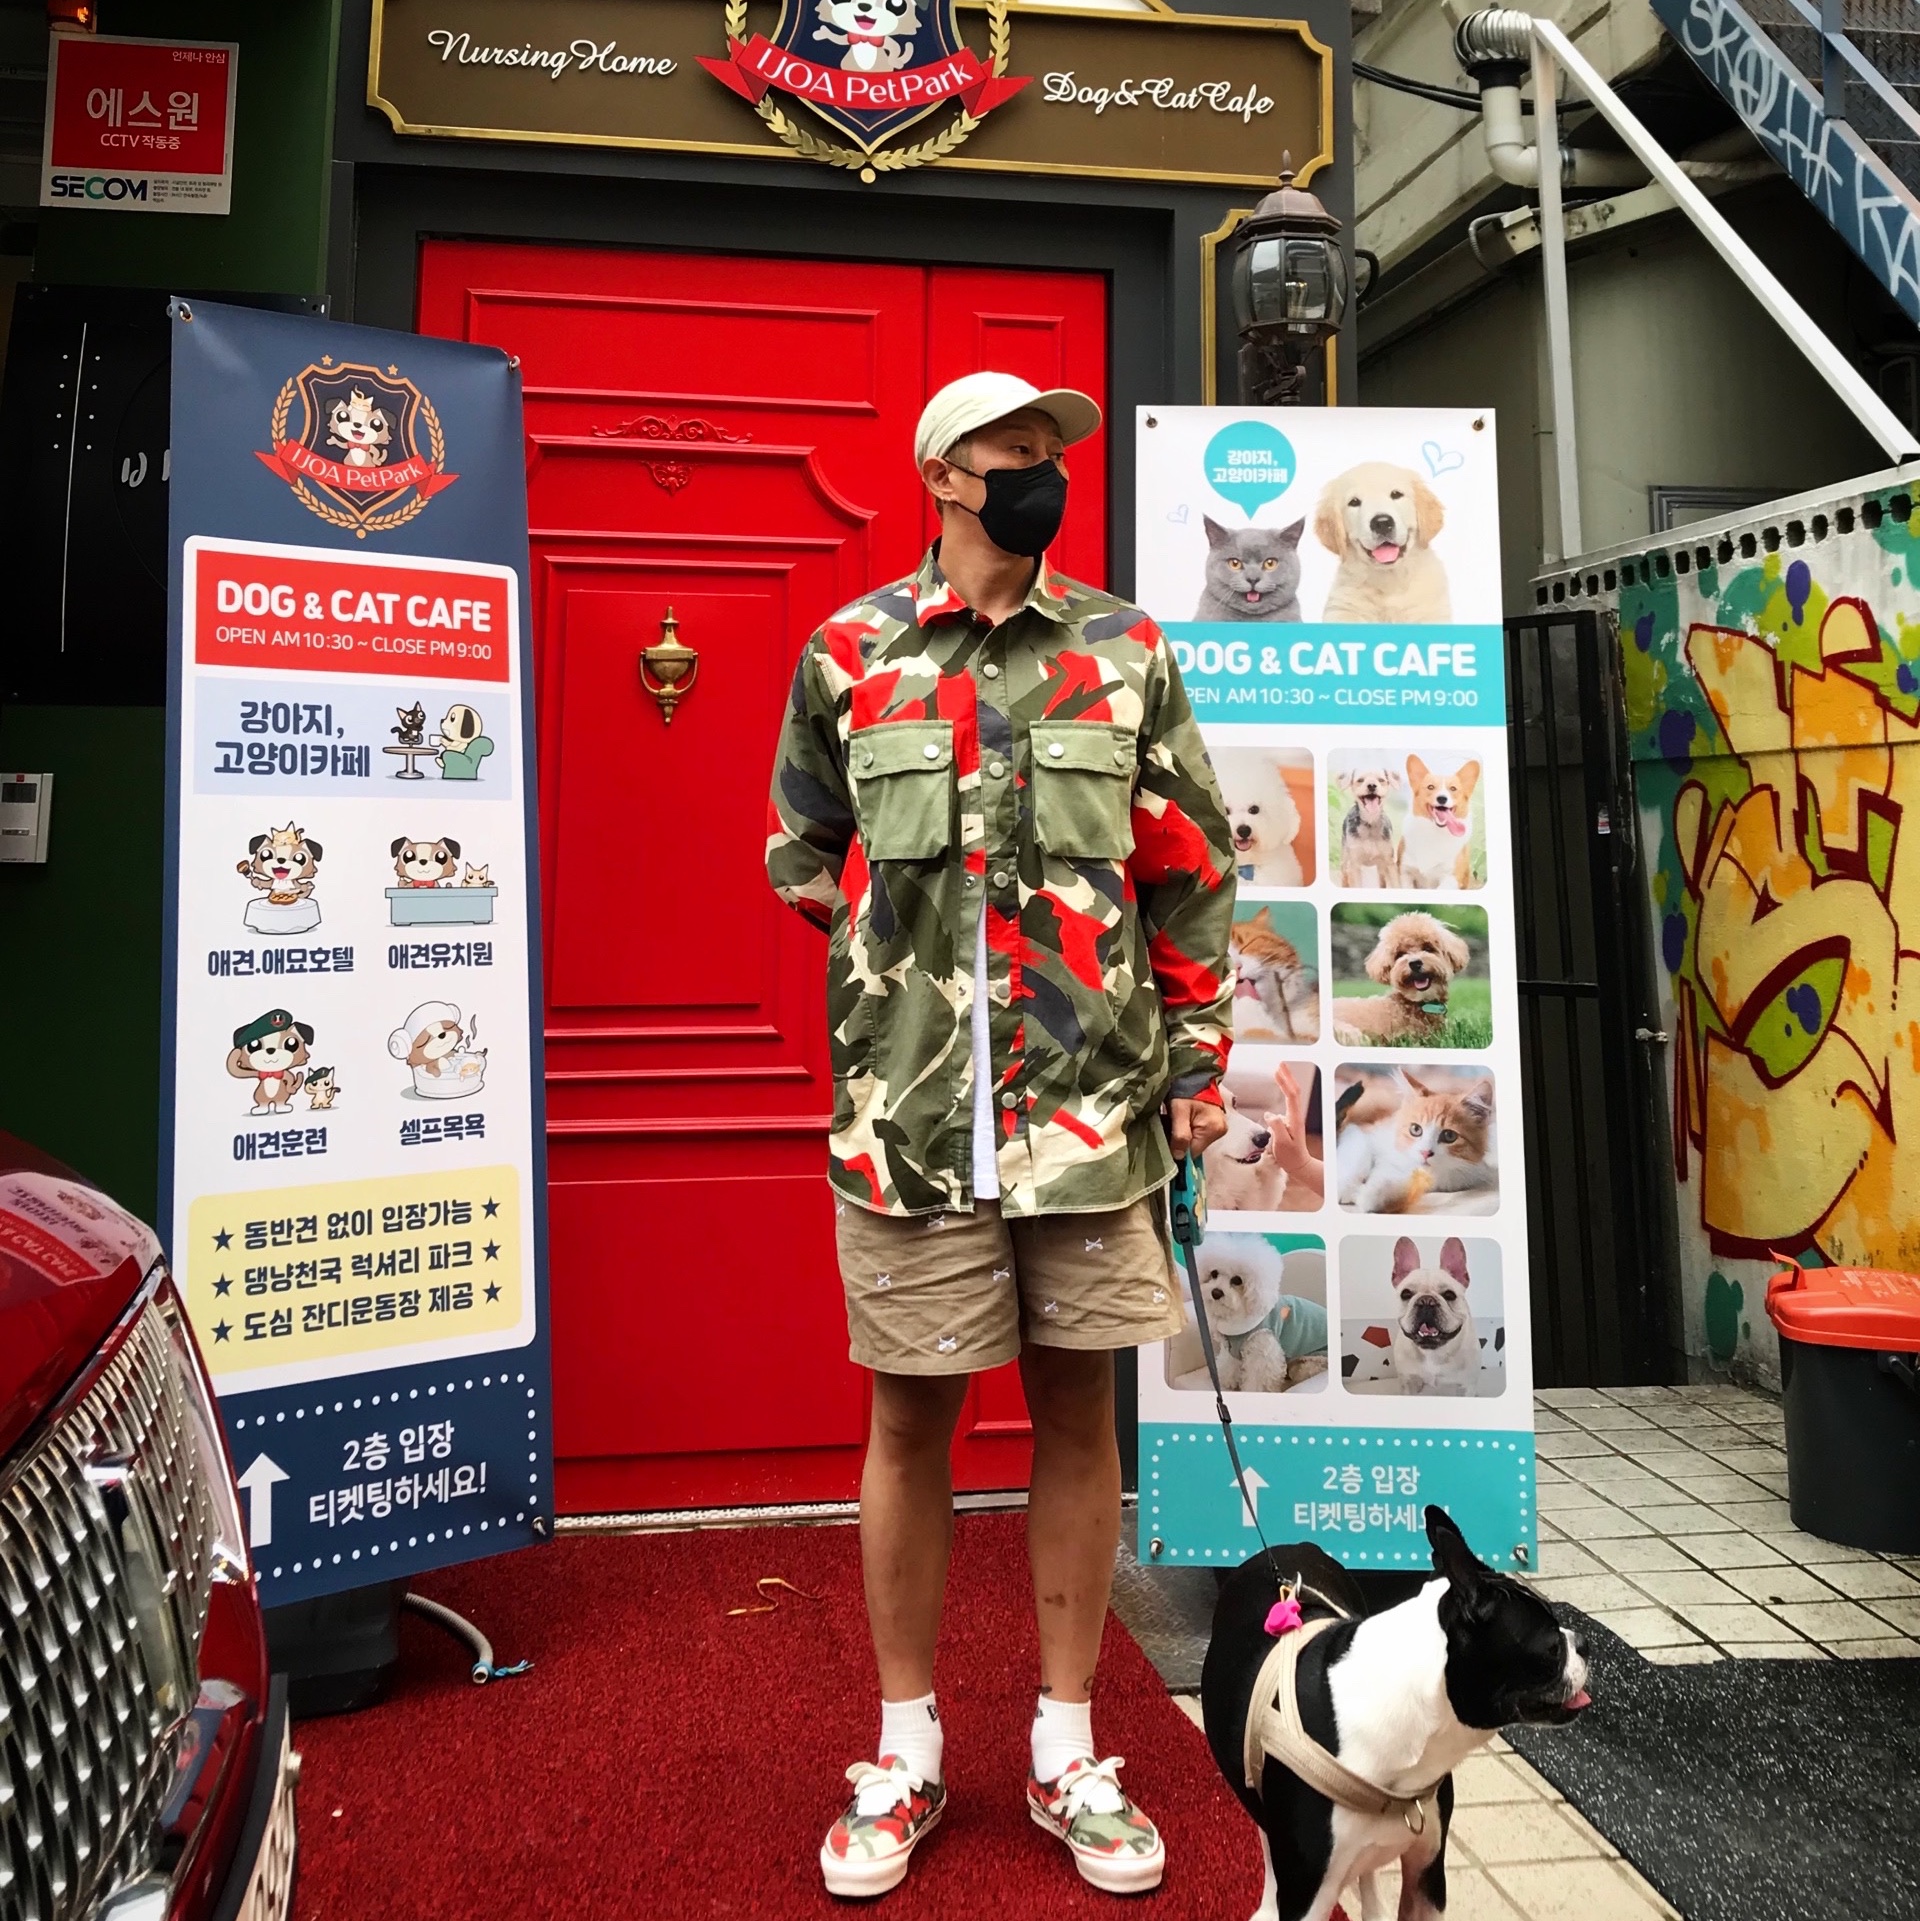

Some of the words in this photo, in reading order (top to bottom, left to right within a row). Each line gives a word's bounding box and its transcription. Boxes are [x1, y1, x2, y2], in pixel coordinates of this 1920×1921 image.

[172, 51, 203, 63] 언제나
[205, 52, 226, 64] 안심
[756, 47, 835, 99] IJOA
[86, 87, 198, 131] 에스원
[100, 133, 140, 148] CCTV
[141, 134, 181, 150] 작동중
[51, 174, 147, 201] SECOM
[292, 448, 340, 483] IJOA
[1226, 449, 1279, 468] 강아지,
[1212, 468, 1288, 485] 고양이카페
[217, 579, 296, 618] DOG
[303, 592, 325, 620] &
[331, 589, 400, 625] CAT
[406, 595, 492, 633] CAFE
[216, 626, 266, 646] OPEN
[372, 636, 427, 656] CLOSE
[1259, 646, 1283, 675] &
[1288, 640, 1367, 676] CAT
[1373, 642, 1477, 678] CAFE
[1184, 687, 1220, 704] PEN
[1334, 688, 1397, 707] CLOSE
[239, 700, 344, 739] 강아지,
[213, 740, 370, 778] 고양이카페
[207, 946, 355, 977] 애견.애묘호텔
[387, 941, 494, 970] 애견유치원
[232, 1126, 328, 1161] 애견훈련
[399, 1113, 486, 1146] 셀프목욕
[244, 1215, 318, 1250] 동반견
[327, 1208, 373, 1241] 없이
[381, 1198, 473, 1237] 입장가능
[244, 1256, 342, 1297] 댕냥천국
[350, 1246, 420, 1281] 럭셔리
[428, 1240, 474, 1270] 파크
[243, 1307, 293, 1342] 도심
[301, 1289, 422, 1333] 잔디운동장
[428, 1281, 474, 1314] 제공
[342, 1431, 391, 1471] 2층
[398, 1420, 455, 1465] 입장
[309, 1461, 487, 1528] 티켓팅하세요!
[1322, 1464, 1364, 1494] 2층
[1372, 1464, 1421, 1496] 입장
[1293, 1502, 1449, 1533] 티켓팅하세
